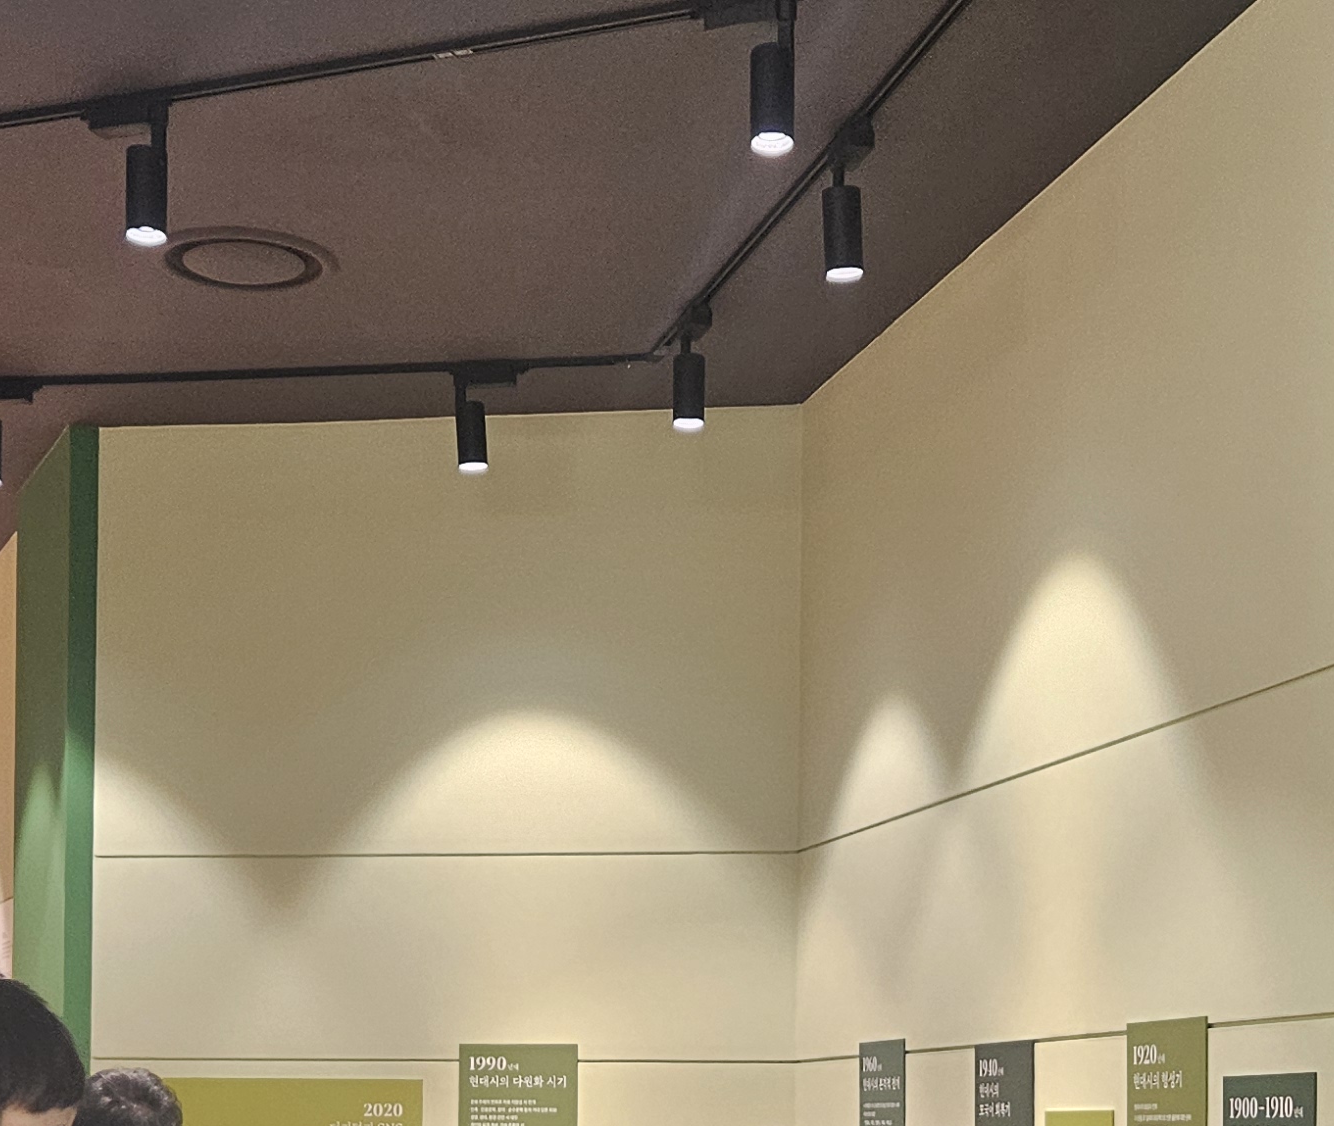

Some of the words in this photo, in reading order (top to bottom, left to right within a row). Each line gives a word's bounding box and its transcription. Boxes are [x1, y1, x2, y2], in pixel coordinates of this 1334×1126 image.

[469, 1075, 509, 1088] 현대시의
[513, 1075, 544, 1088] 다원화
[547, 1075, 567, 1088] 시기
[1133, 1071, 1160, 1090] 현대시의
[363, 1103, 403, 1117] 2020
